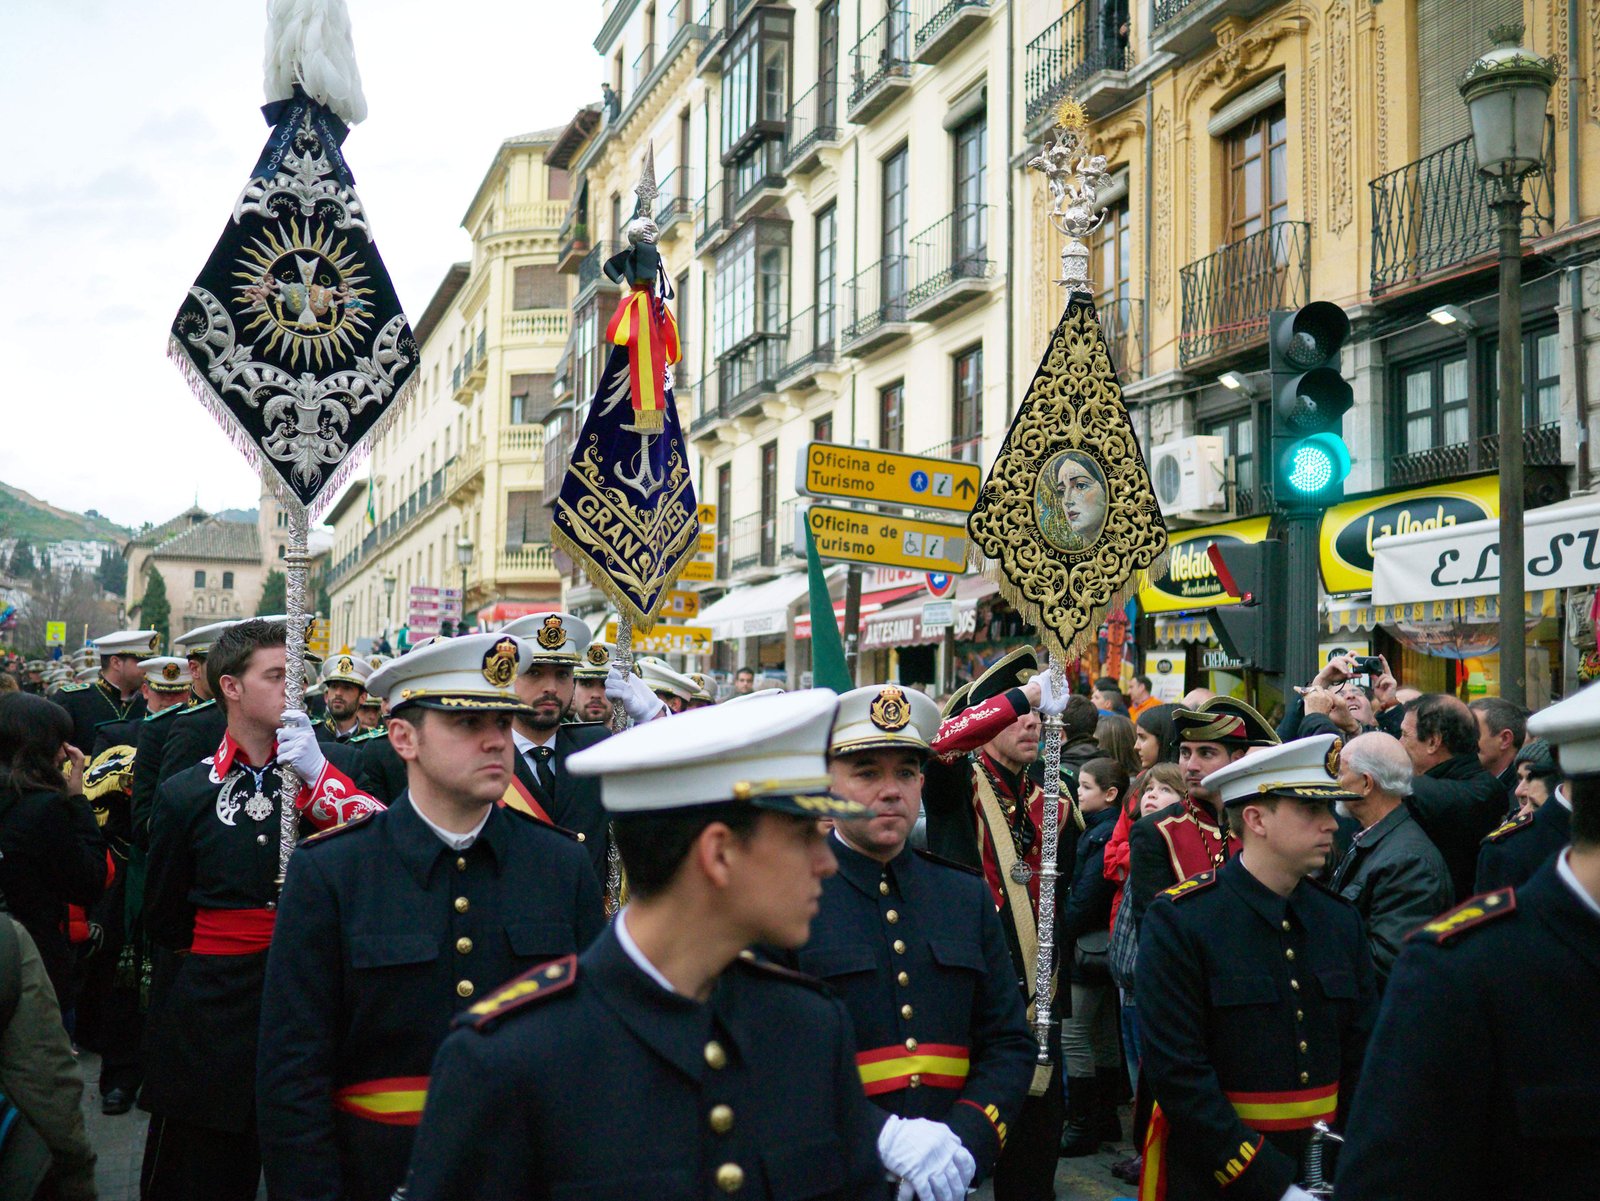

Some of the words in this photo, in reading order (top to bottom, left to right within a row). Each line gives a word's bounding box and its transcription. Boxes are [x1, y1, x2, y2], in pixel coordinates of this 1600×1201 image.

[813, 451, 870, 472] Oficina
[877, 462, 896, 475] de
[812, 471, 875, 491] Turismo
[576, 495, 641, 559] GRAN
[649, 501, 689, 562] PODER
[812, 514, 869, 535] Oficina
[880, 525, 898, 538] de
[812, 534, 875, 555] Turismo
[1055, 552, 1067, 563] LA
[1069, 537, 1106, 563] ESTRELLA
[1361, 605, 1421, 622] HELADOS
[1435, 596, 1500, 615] ARTESAN
[865, 619, 913, 644] ARTESANIA
[921, 609, 976, 638] RECUDOS
